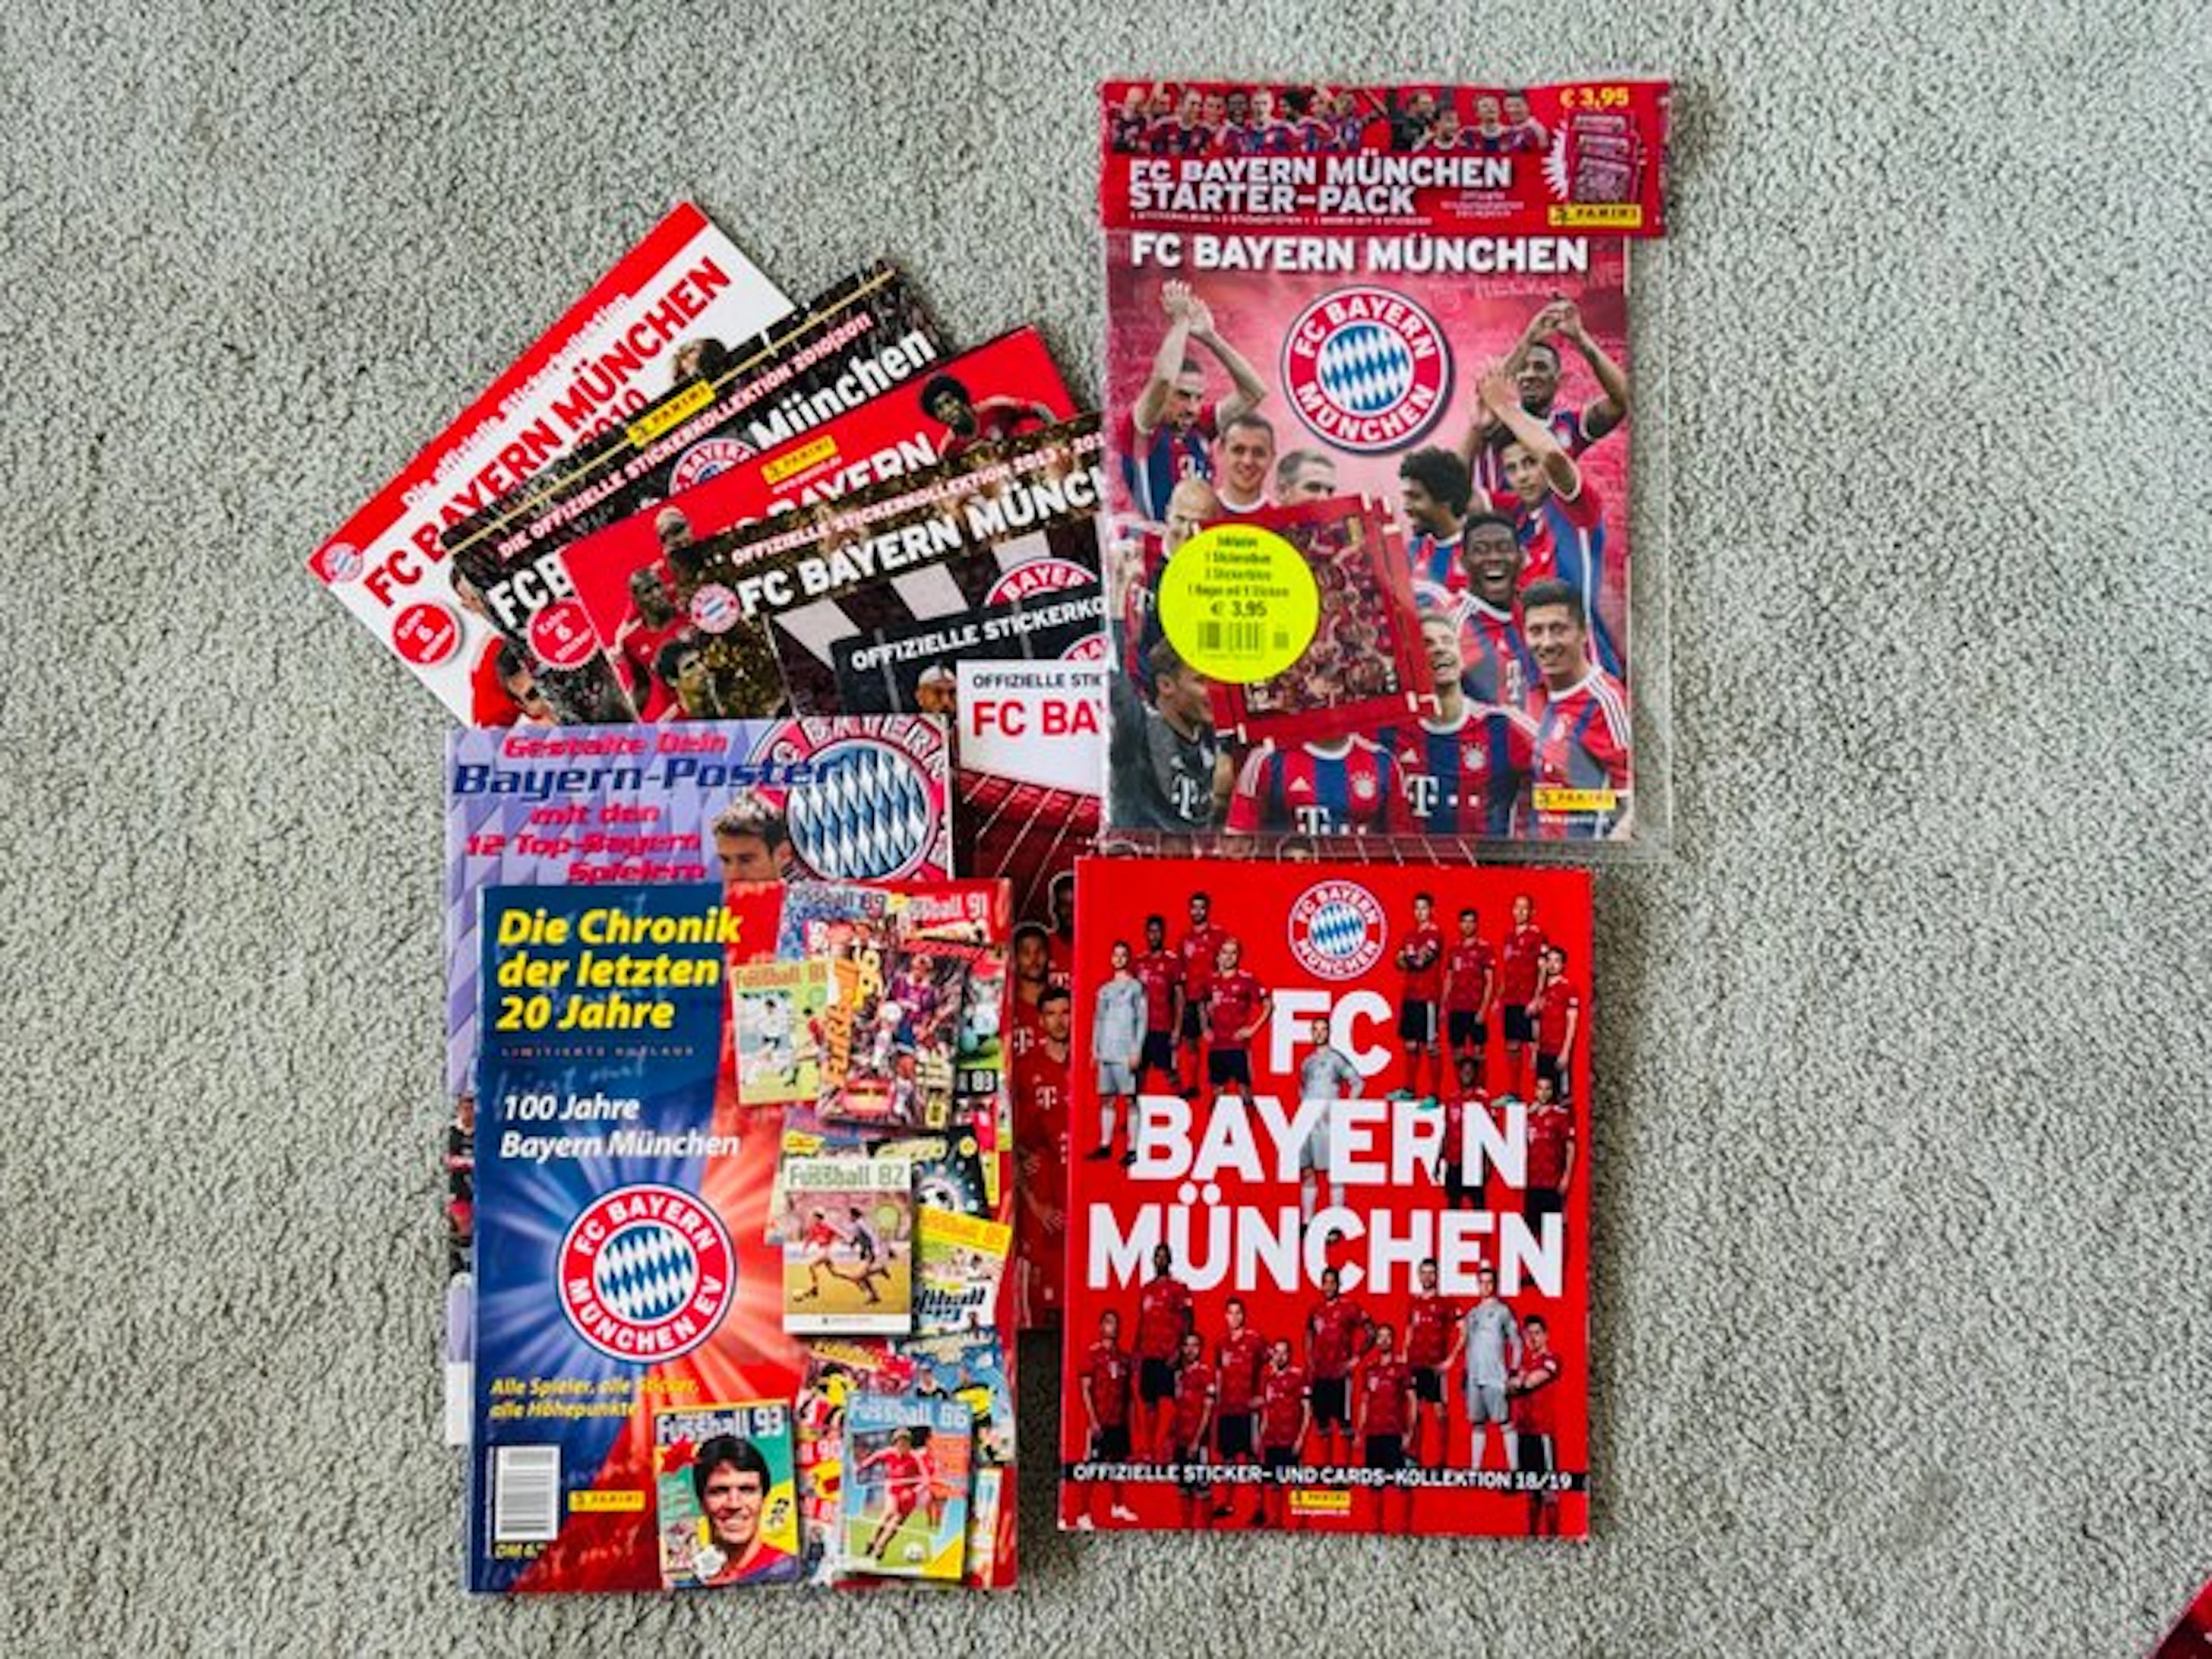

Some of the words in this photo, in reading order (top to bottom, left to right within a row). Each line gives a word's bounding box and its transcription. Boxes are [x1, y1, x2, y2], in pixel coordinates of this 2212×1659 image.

[1579, 86, 1630, 108] 3,95
[1129, 158, 1172, 183] FC
[1180, 157, 1317, 185] BAYERN
[1325, 147, 1512, 188] MÜNCHEN
[1129, 182, 1417, 215] STARTER-PACK
[1577, 207, 1638, 219] PANINI
[1131, 232, 1182, 267] FC
[1193, 234, 1355, 271] BAYERN
[1367, 232, 1589, 272] MÜNCHEN
[1294, 319, 1325, 359] FC
[1324, 296, 1437, 359] BAYERN
[748, 328, 937, 450] München
[1296, 381, 1437, 442] MÜNCHEN
[363, 550, 423, 609] FC
[550, 256, 731, 426] MÜNCHEN
[498, 531, 533, 559] DIE
[530, 471, 627, 539] OFFIZIELLE
[624, 368, 795, 485] STICKERKOLLEKTION
[731, 520, 833, 566] OFFIZIELLE
[837, 459, 1010, 529] STICKERKOLLEKTION
[736, 570, 795, 616] FC
[799, 514, 962, 596] BAYERN
[1232, 601, 1267, 616] 3,95
[851, 624, 980, 671] OFFIZIELLE
[973, 672, 1065, 688] OFFIZIELLE
[972, 699, 1027, 737] FC
[1042, 699, 1101, 736] BA
[453, 758, 842, 801] Bayern-Poster
[531, 802, 588, 824] mit
[599, 803, 660, 824] den
[467, 834, 506, 857] 12
[516, 831, 702, 858] Top-Bayern
[568, 861, 708, 884] Spielern
[497, 908, 570, 945] Die
[578, 905, 744, 944] Chronik
[497, 949, 570, 987] der
[576, 949, 721, 987] letzten
[495, 994, 552, 1031] 20
[556, 993, 676, 1030] Jahre
[1270, 988, 1393, 1077] FC
[505, 1094, 557, 1121] 100
[558, 1092, 641, 1121] Jahre
[500, 1130, 603, 1164] Bayern
[607, 1126, 741, 1158] München
[1127, 1096, 1528, 1188] BAYERN
[573, 1219, 605, 1256] FC
[606, 1194, 718, 1252] BAYERN
[1088, 1183, 1564, 1298] MÜNCHEN
[567, 1277, 697, 1353] MÜNCHEN
[755, 1406, 785, 1437] 93
[1073, 1462, 1180, 1482] OFFIZIELLE
[1183, 1463, 1274, 1483] STICKER-
[1275, 1464, 1318, 1483] UND
[1320, 1465, 1512, 1487] CARDS-KOLLEKTION
[1514, 1471, 1572, 1490] 18/19
